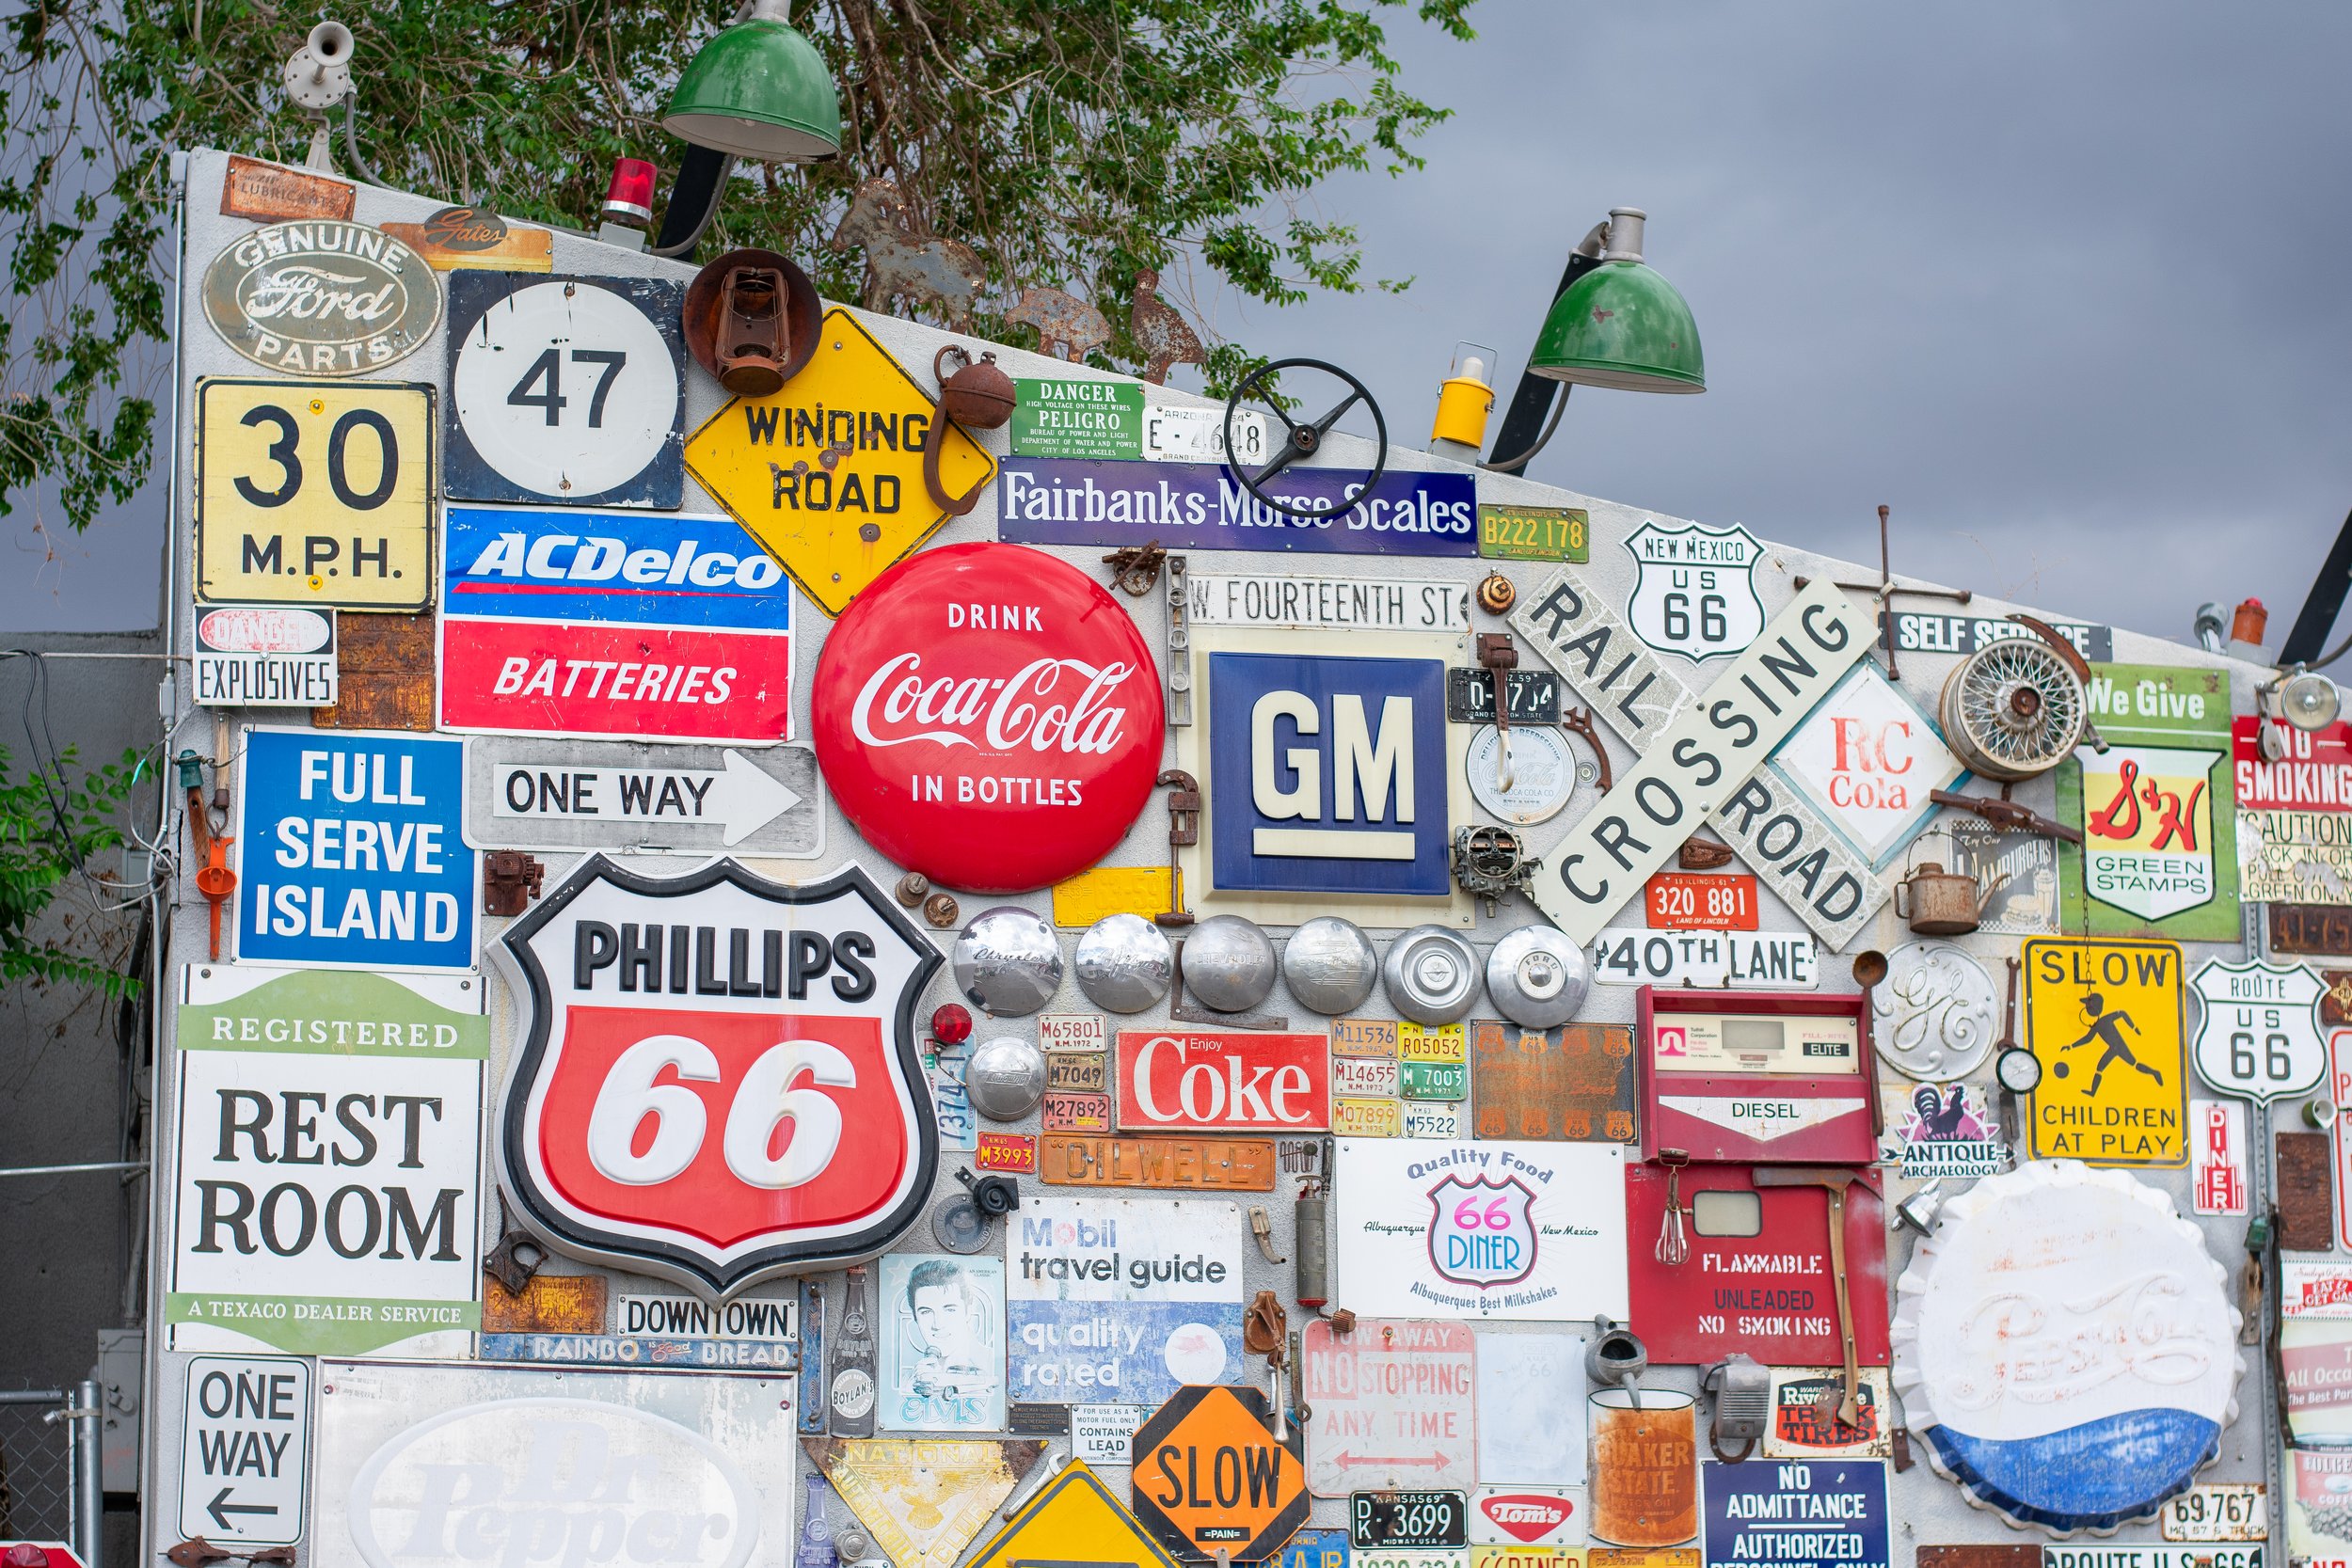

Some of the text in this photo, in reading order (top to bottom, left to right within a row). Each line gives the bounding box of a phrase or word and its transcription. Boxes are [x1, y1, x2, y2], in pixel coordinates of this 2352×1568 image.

[425, 209, 508, 247] Gates
[233, 221, 411, 273] GENUINE
[245, 264, 394, 320] Ford
[252, 332, 396, 373] PARTS
[506, 347, 628, 429] 47
[1040, 382, 1118, 403] DANGER
[1025, 400, 1131, 412] HIGH VOLTAGE ON THESE WIRES
[1038, 409, 1120, 430] PELIGRO
[744, 404, 930, 452] WINDING
[1021, 436, 1138, 449] DEPARTMENT OF WATER AND POWER
[1029, 428, 1056, 436] BUREAU
[1069, 429, 1092, 438] POWER
[1093, 430, 1108, 438] AND
[1109, 431, 1129, 439] LIGHT
[232, 404, 400, 510] 30
[1041, 446, 1117, 456] CITY OF LOS ANGELES
[772, 470, 901, 515] ROAD
[1003, 471, 1471, 535] Fairbanks-Morse Scales
[1484, 515, 1583, 550] B222 178
[1645, 537, 1745, 562] NEW MEXICO
[241, 533, 403, 579] M.P.H.
[466, 532, 784, 590] ACDelco
[947, 602, 1044, 632] DRINK
[1189, 578, 1457, 627] W. FOURTEENTH ST.
[1663, 593, 1726, 641] 66
[1899, 614, 1966, 652] SELF
[1529, 581, 1657, 730] RAIL
[199, 659, 330, 701] EXPLOSIVES
[492, 657, 739, 705] BATTERIES
[850, 652, 1137, 754] Coca-Cola
[2085, 677, 2205, 721] We Give
[1251, 689, 1415, 823] GM
[1559, 604, 1849, 905] CROSSING
[1830, 716, 1915, 776] RC
[2275, 723, 2312, 760] NO
[299, 750, 426, 807] FULL
[505, 769, 714, 817] ONE WAY
[912, 774, 1083, 807] IN BOTTLES
[1828, 774, 1911, 811] Cola
[2236, 759, 2352, 804] SMOKING
[2088, 757, 2206, 853] S&H
[276, 816, 444, 875] SERVE
[1719, 776, 1864, 922] ROAD
[2095, 855, 2203, 876] GREEN
[1655, 886, 1746, 917] 320 881
[2096, 875, 2207, 895] STAMPS
[254, 883, 459, 942] ISLAND
[573, 919, 877, 1004] PHILLIPS
[1607, 936, 1807, 982] 40TH LANE
[2041, 950, 2169, 988] SLOW
[2230, 975, 2287, 1000] ROUTE
[212, 1016, 459, 1050] REGISTERED
[1041, 1021, 1103, 1039] M65801
[1190, 1038, 1222, 1053] Enjoy
[1334, 1025, 1394, 1044] M11536
[1403, 1037, 1460, 1055] R05052
[1809, 1043, 1842, 1056] ELITE
[2230, 1032, 2291, 1081] 66
[1049, 1066, 1102, 1084] M7049
[1134, 1037, 1311, 1124] Coke
[1335, 1064, 1396, 1084] M14655
[586, 1034, 857, 1190] 66
[1044, 1099, 1107, 1119] M27892
[1335, 1105, 1395, 1124] M07899
[1406, 1116, 1456, 1133] M5522
[1731, 1101, 1801, 1119] DIESEL
[2042, 1104, 2177, 1129] CHILDREN
[212, 1088, 443, 1169] REST
[2052, 1132, 2171, 1156] AT PLAY
[979, 1145, 1033, 1166] M3993
[1406, 1148, 1554, 1186] Quality Food
[1903, 1141, 1998, 1163] ANTIQUE
[2209, 1108, 2228, 1210] DINER
[1902, 1164, 2000, 1178] ARCHAEOLOGY
[190, 1180, 465, 1262] ROOM
[1363, 1219, 1599, 1238] Albuquerque New Mexico
[1454, 1195, 1512, 1231] 66
[1022, 1217, 1118, 1249] Mobil
[1020, 1250, 1227, 1289] travel guide
[1447, 1233, 1521, 1271] DINER
[1702, 1252, 1823, 1275] FLAMMABLE
[188, 1301, 462, 1324] A TEXACO DEALER SERVICE
[1409, 1280, 1559, 1310] Albuquerques Best Milkshakes
[1714, 1288, 1814, 1311] UNLEADED
[627, 1300, 788, 1337] DOWNTOWN
[1021, 1316, 1144, 1356] quality
[1697, 1314, 1832, 1338] NO SMOKING
[532, 1336, 640, 1362] RAINBO
[651, 1341, 691, 1363] good
[702, 1341, 790, 1367] BREAD
[1023, 1355, 1120, 1388] rated
[1311, 1351, 1356, 1394] NO
[1360, 1361, 1470, 1396] STOPPING
[199, 1370, 296, 1420] ONE
[833, 1379, 875, 1406] BOYLAN'S
[1079, 1427, 1134, 1437] CONTAINS
[1325, 1411, 1459, 1439] ANY TIME
[1782, 1421, 1871, 1446] TIRES
[199, 1429, 292, 1479] WAY
[506, 1419, 660, 1504] Dr
[848, 1444, 1002, 1465] NATIONAL
[1088, 1439, 1125, 1451] LEAD
[1156, 1445, 1282, 1510] SLOW
[1778, 1464, 1812, 1491] NO
[1392, 1504, 1453, 1538] 3699
[1489, 1502, 1564, 1526] Tom's
[1726, 1493, 1867, 1519] ADMITTANCE
[1382, 1538, 1416, 1546] MIDWAY
[1732, 1533, 1864, 1560] AUTHORIZED
